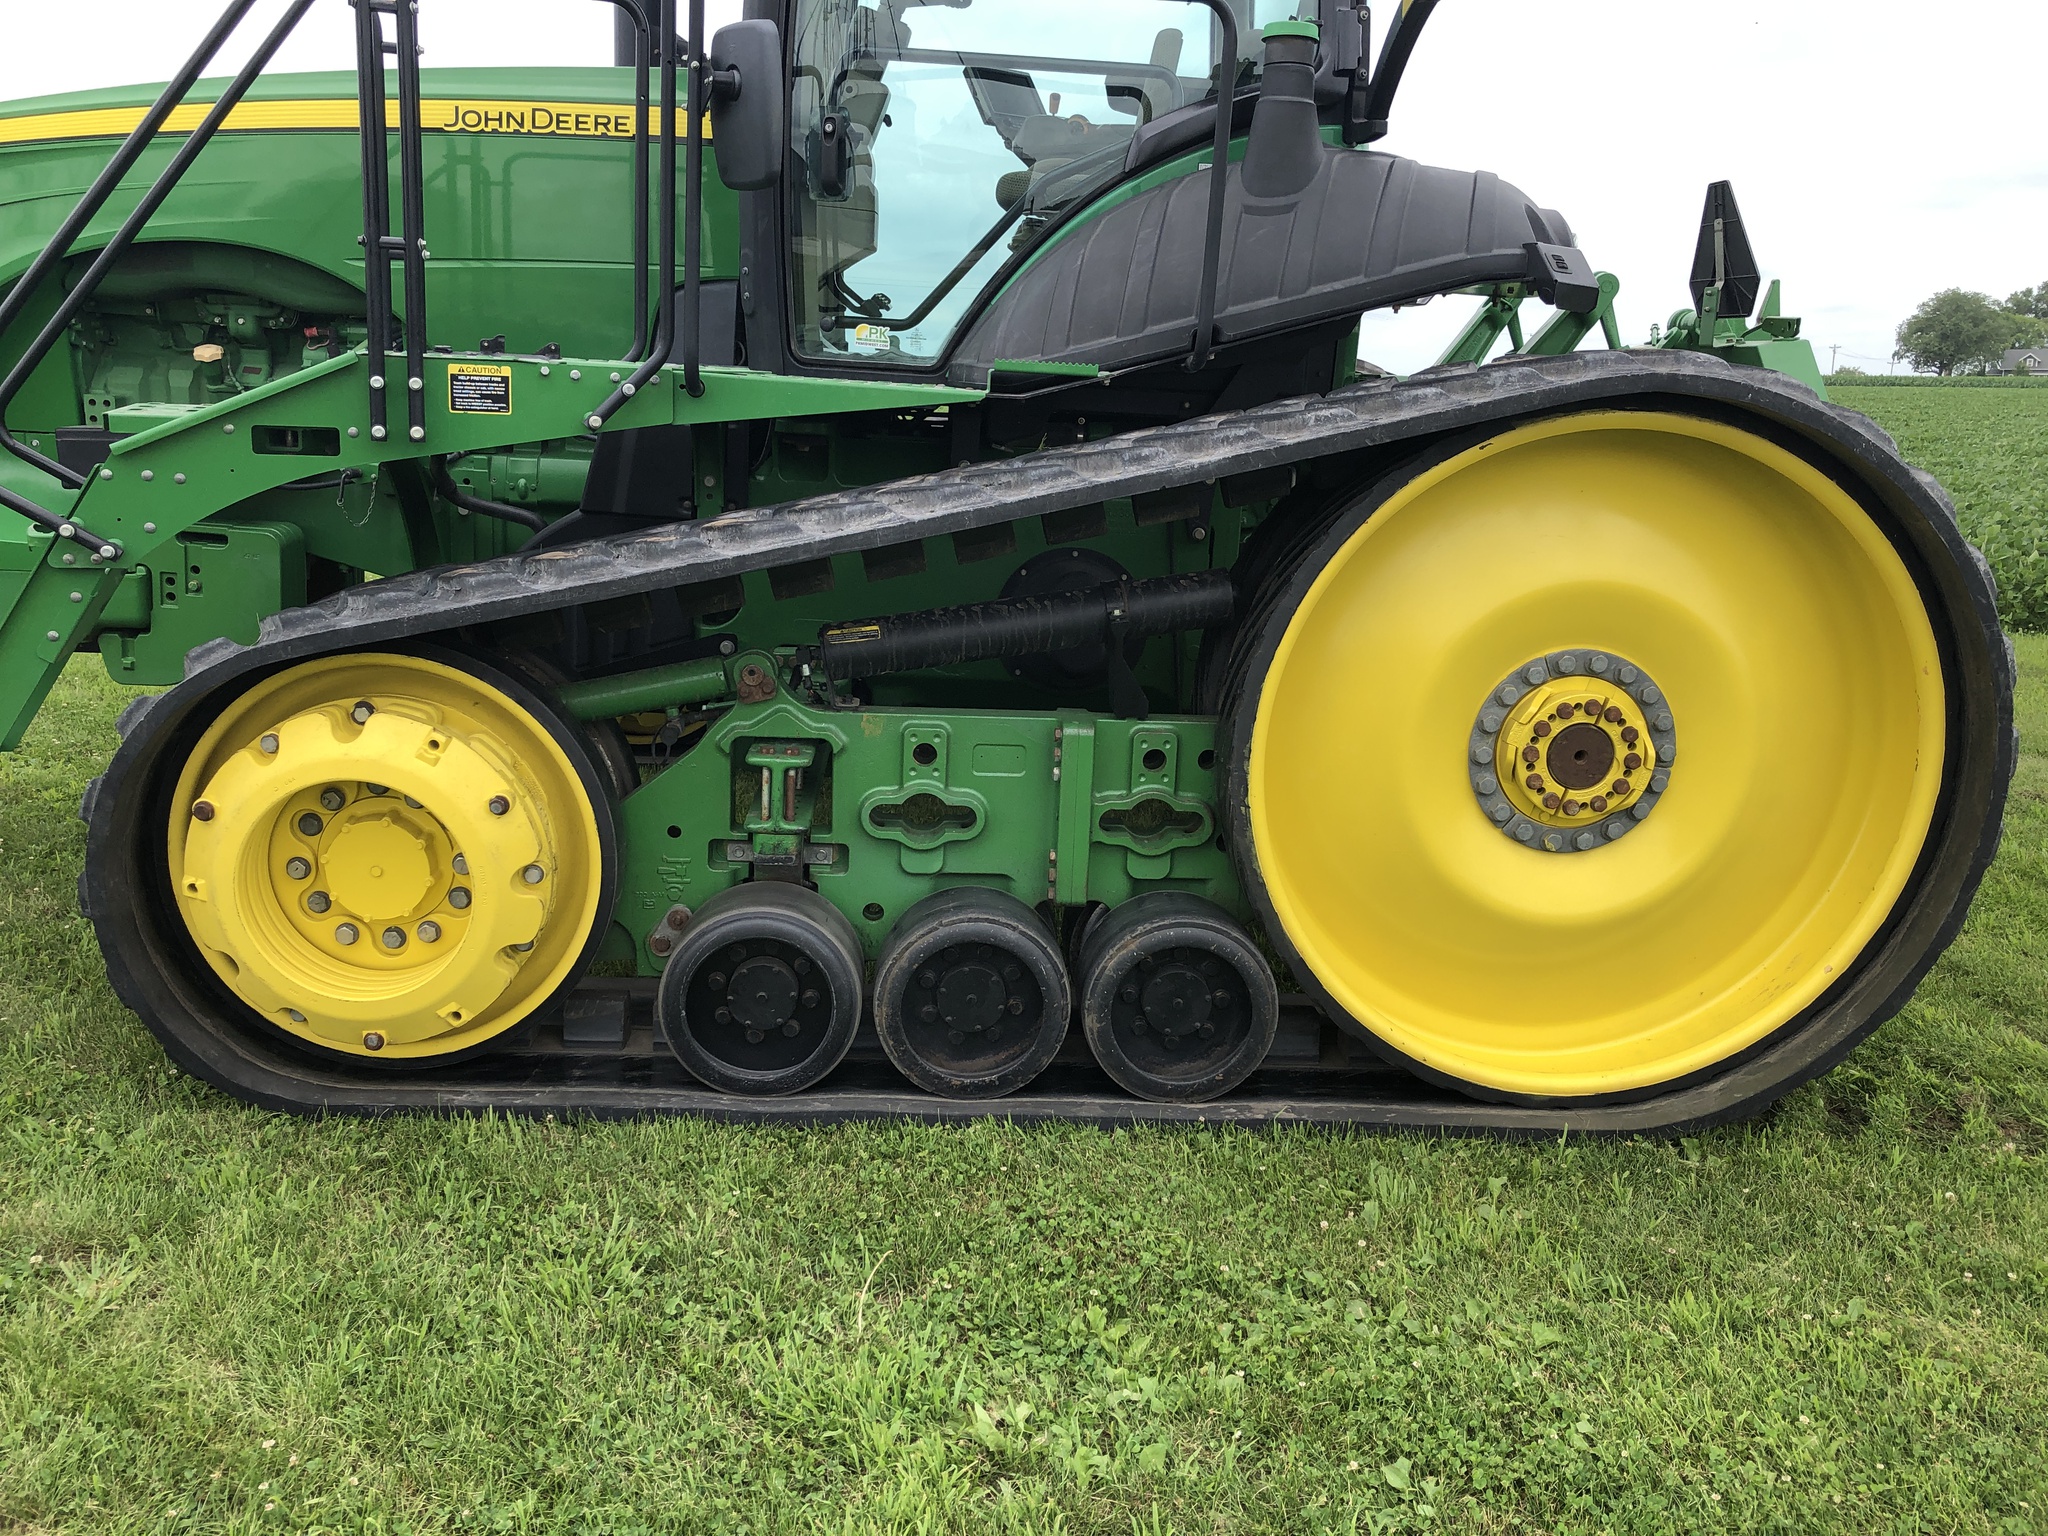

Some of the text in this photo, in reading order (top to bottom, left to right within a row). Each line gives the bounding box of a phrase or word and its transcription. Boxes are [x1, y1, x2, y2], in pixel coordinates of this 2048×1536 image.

[444, 105, 631, 134] JOHN DEERE
[869, 327, 888, 340] PK
